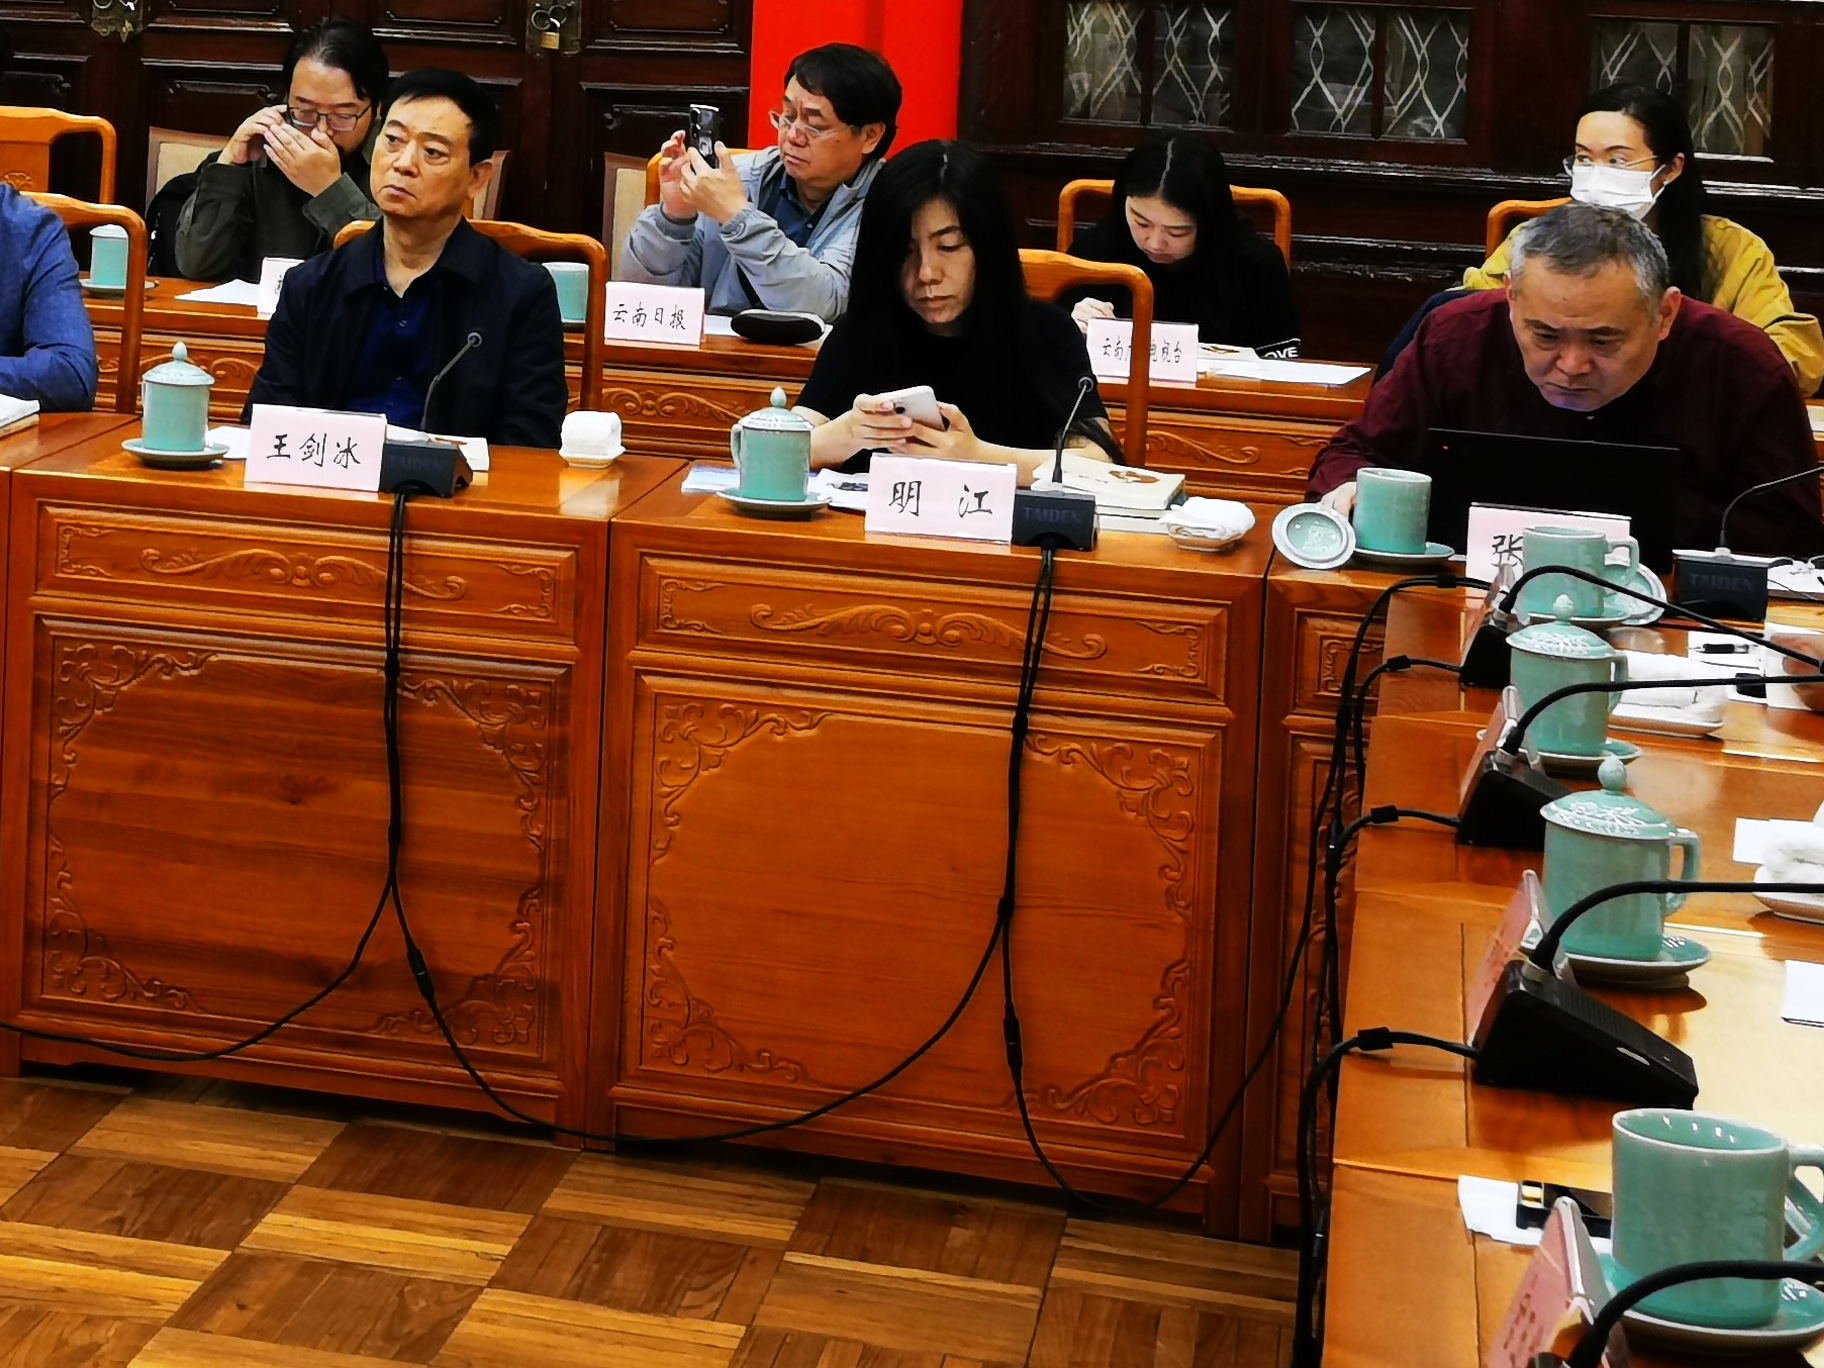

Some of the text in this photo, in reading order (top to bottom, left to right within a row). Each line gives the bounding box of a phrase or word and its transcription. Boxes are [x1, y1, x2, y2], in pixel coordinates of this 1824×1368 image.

[613, 301, 686, 330] 云南日报
[266, 432, 361, 470] 王剑冰
[888, 480, 993, 518] 明江
[1023, 505, 1083, 524] TAIDEN
